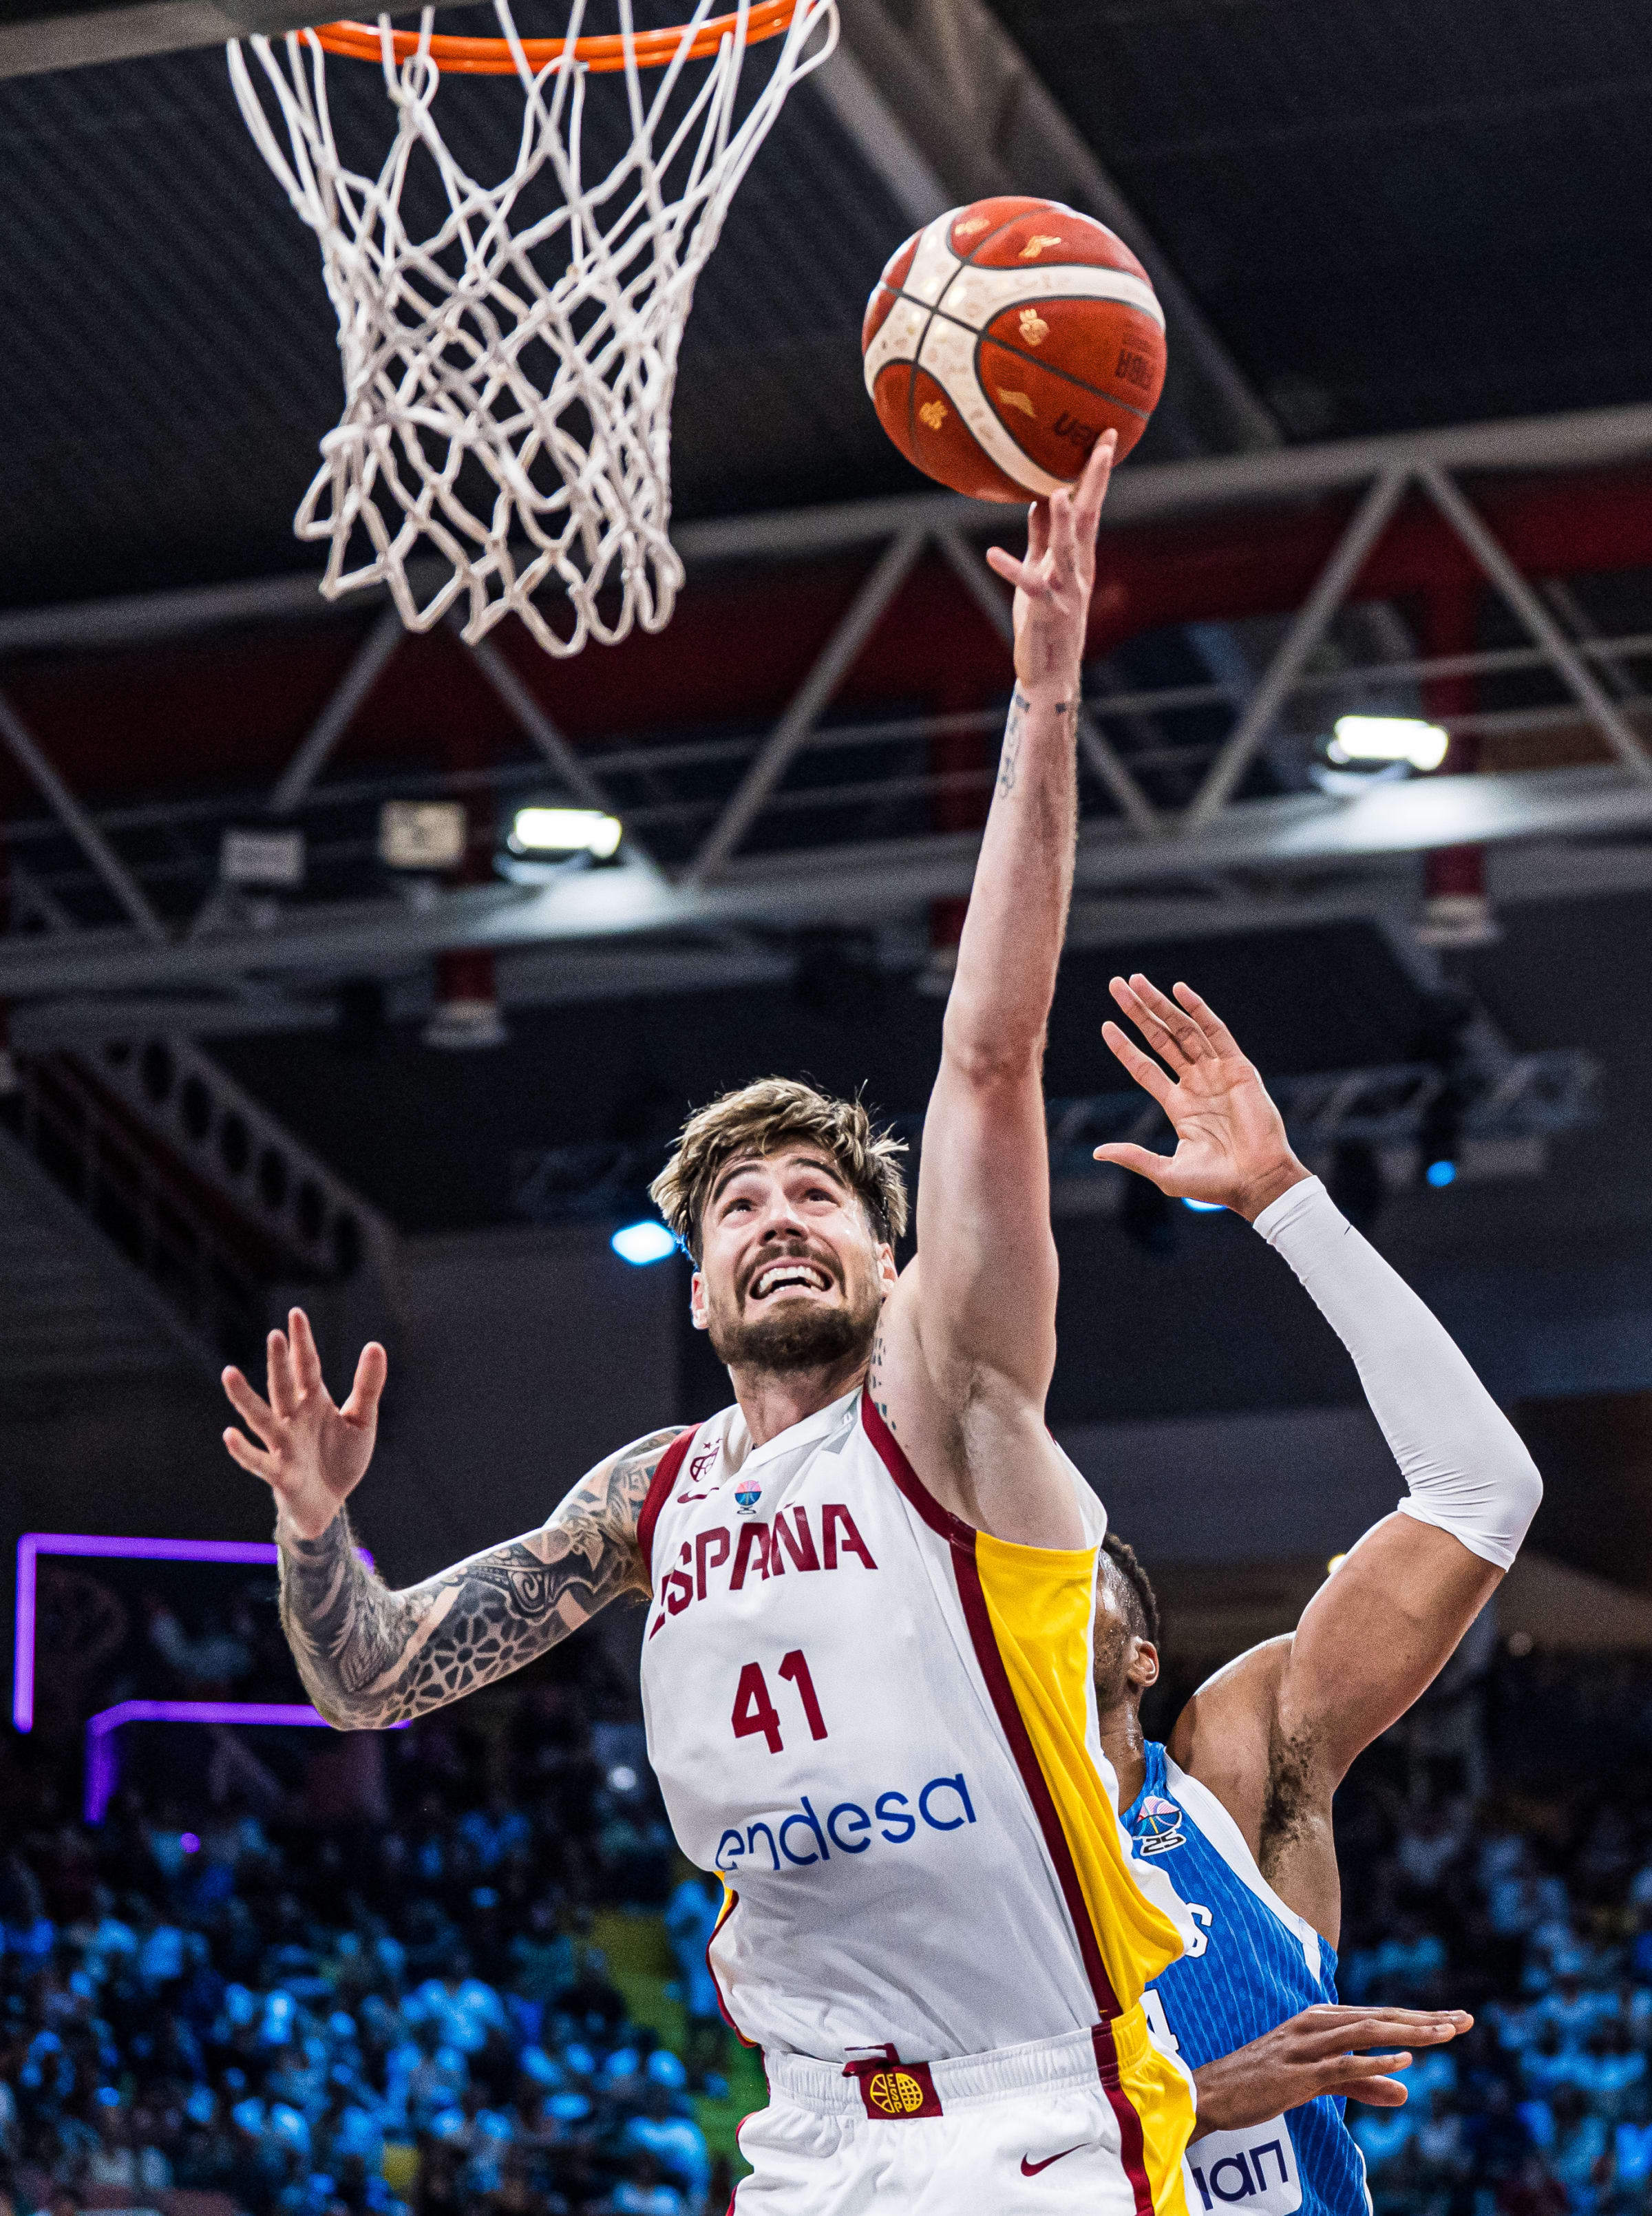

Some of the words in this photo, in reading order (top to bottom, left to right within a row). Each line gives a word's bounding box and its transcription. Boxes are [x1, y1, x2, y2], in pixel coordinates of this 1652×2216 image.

[731, 1649, 828, 1754] 41
[715, 1773, 977, 1872] endesa
[1143, 1830, 1184, 1853] 25
[886, 2073, 903, 2113] ESP
